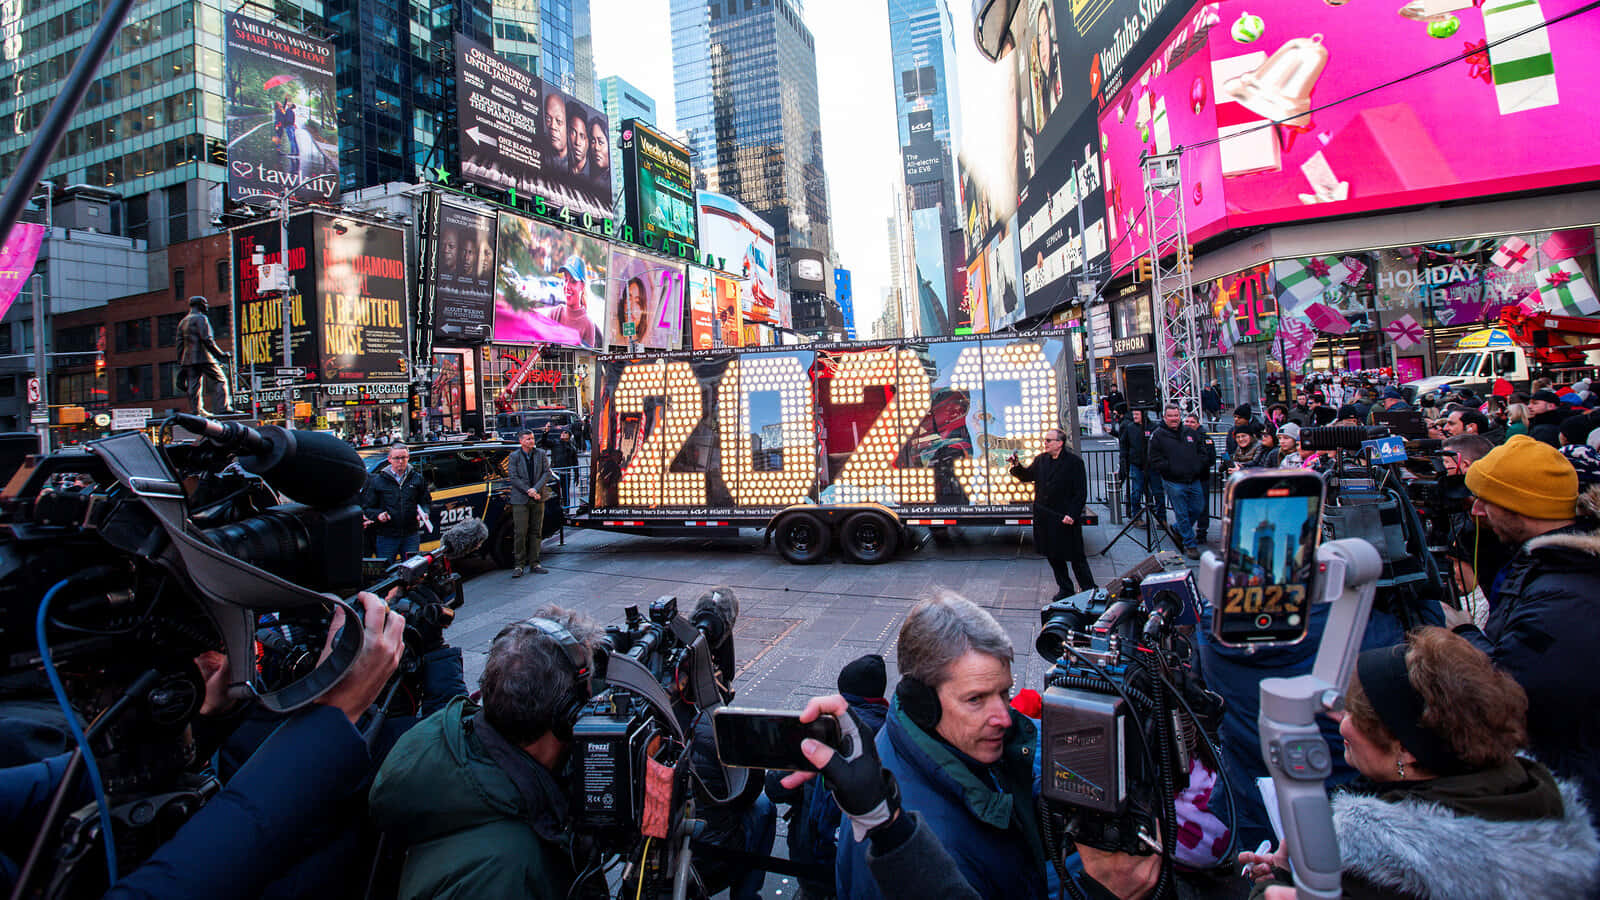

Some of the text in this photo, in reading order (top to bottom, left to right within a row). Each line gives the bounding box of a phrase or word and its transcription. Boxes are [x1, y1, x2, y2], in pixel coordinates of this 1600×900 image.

[232, 18, 330, 57] A MILLION WAYS TO
[235, 29, 268, 46] SHARE
[272, 41, 301, 57] YOUR
[302, 50, 328, 66] LOVE
[1100, 14, 1140, 80] YouTube
[464, 53, 493, 75] UNTIL
[491, 68, 530, 93] JANUARY
[470, 47, 532, 86] ON BROADWAY
[469, 98, 487, 112] THE
[486, 106, 511, 122] PIANO
[510, 117, 537, 134] LESSON
[471, 91, 502, 112] AUGUST
[498, 135, 512, 146] ONE
[512, 141, 532, 155] BLOCK
[623, 141, 633, 149] LG
[640, 135, 668, 166] Vending
[603, 217, 726, 270] BROADWAY
[352, 254, 404, 280] DIAMOND
[1377, 263, 1479, 289] HOLIDAY
[1120, 284, 1137, 297] SEPHORA
[241, 294, 307, 334] A BEAUTUL
[324, 293, 403, 329] A BEAUTIFUL
[241, 331, 273, 366] NOISE
[324, 323, 365, 356] NOISE
[1114, 336, 1146, 352] SEPHORA
[256, 389, 301, 402] LUGGAE
[327, 384, 409, 395] GIFTS LUGGAGE
[614, 342, 1059, 506] 2023
[1381, 442, 1393, 455] 4
[440, 506, 473, 525] 2023
[1224, 584, 1306, 614] 2023
